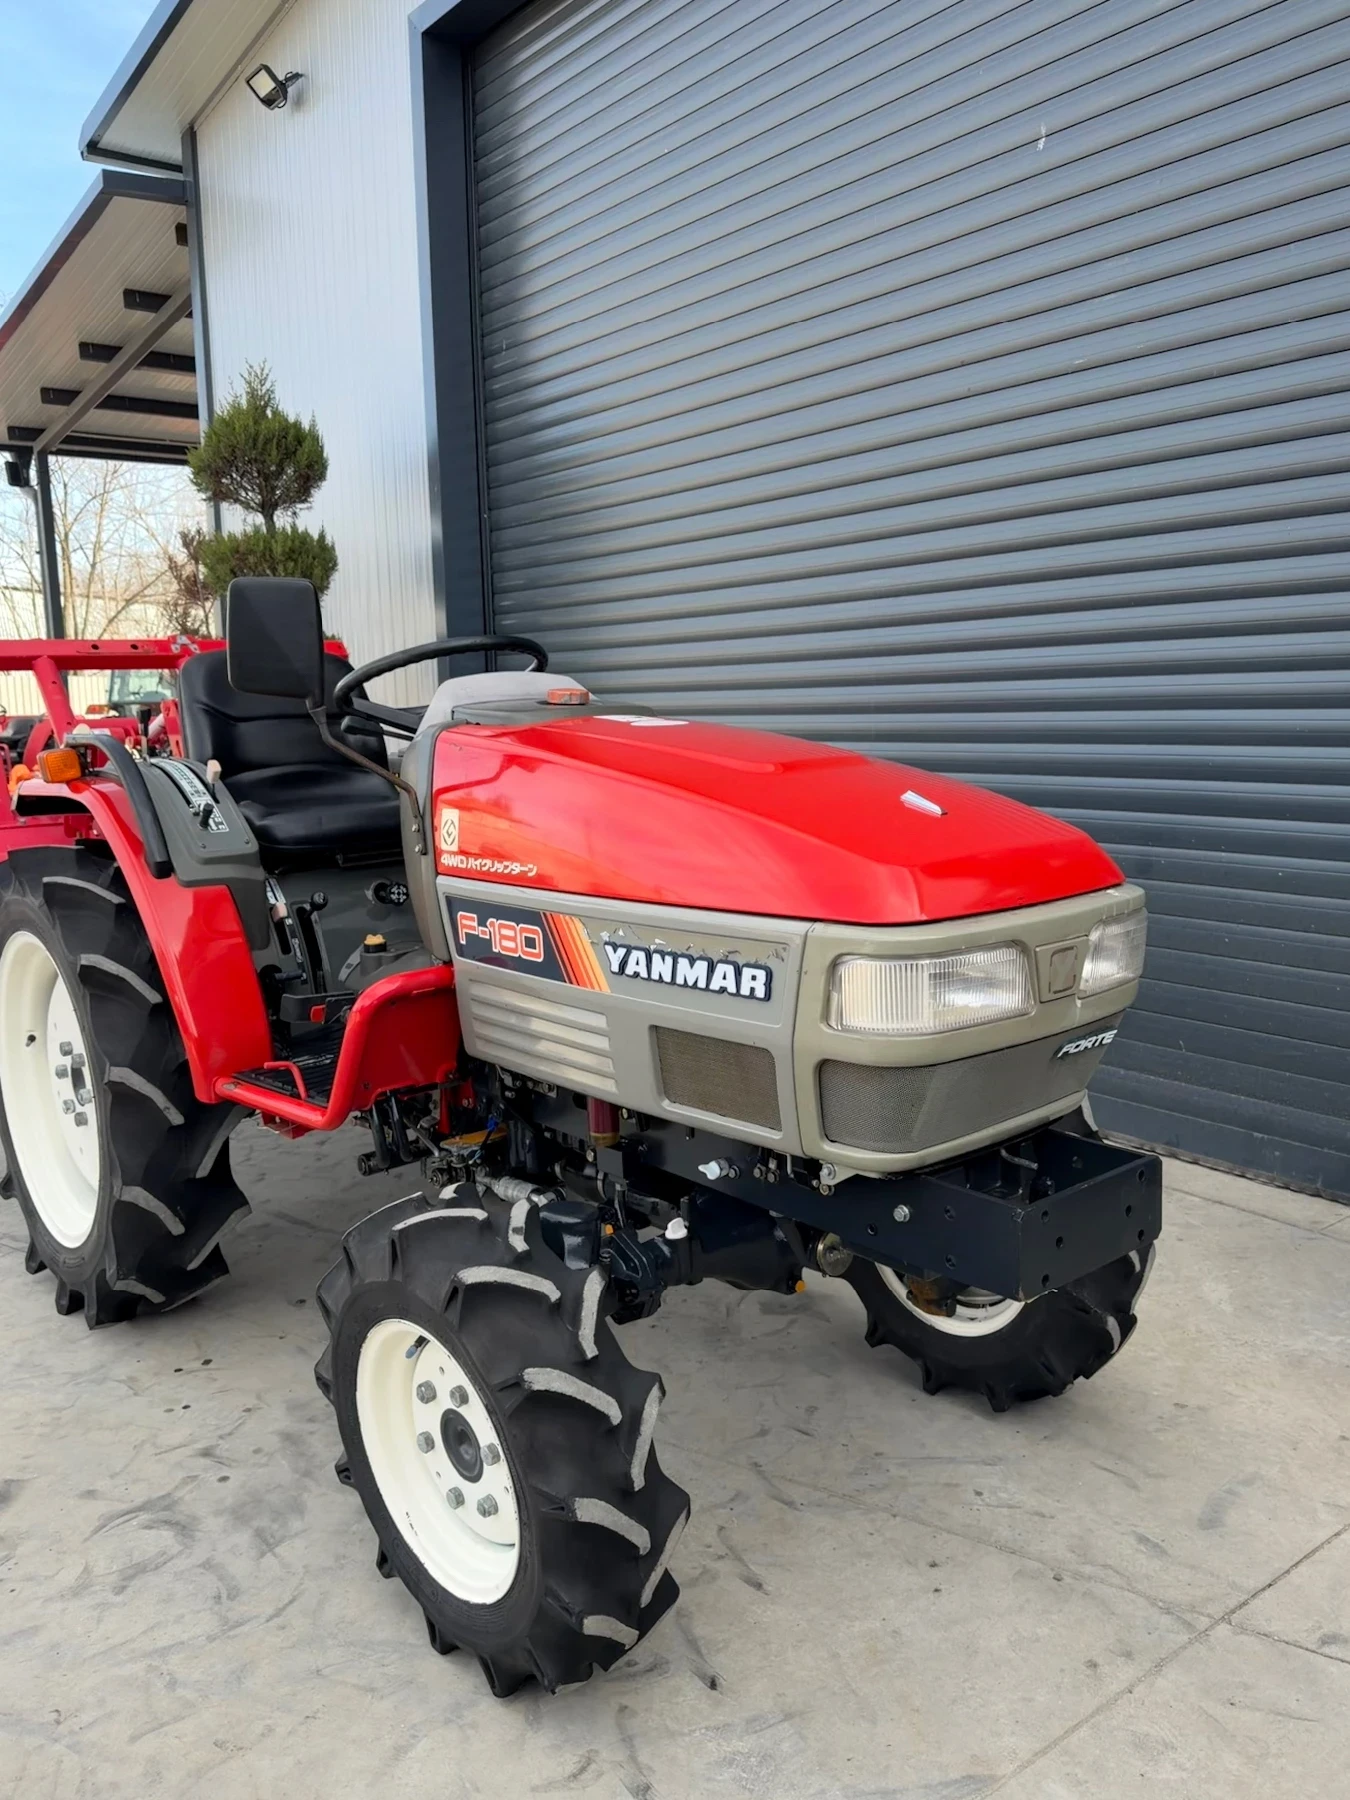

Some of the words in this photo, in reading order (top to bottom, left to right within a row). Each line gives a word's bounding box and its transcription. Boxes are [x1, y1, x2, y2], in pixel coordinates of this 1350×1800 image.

[457, 911, 543, 963] F-180
[604, 942, 771, 1001] YANMAR
[1057, 1029, 1118, 1058] FORTE
